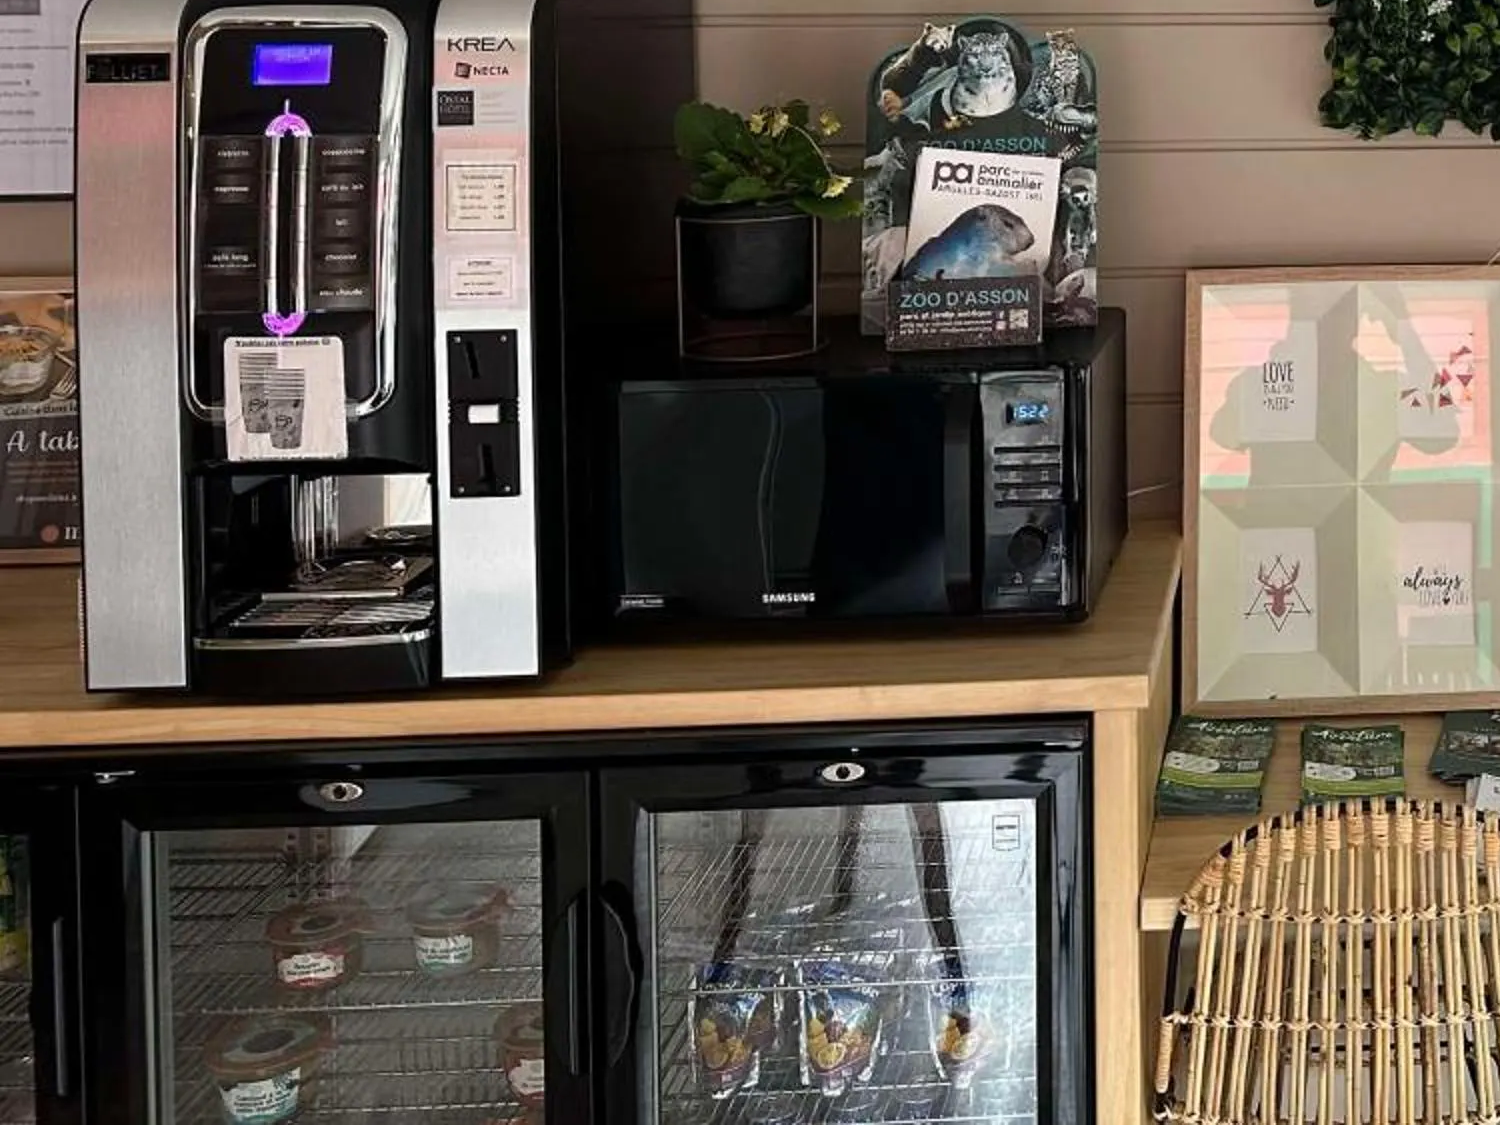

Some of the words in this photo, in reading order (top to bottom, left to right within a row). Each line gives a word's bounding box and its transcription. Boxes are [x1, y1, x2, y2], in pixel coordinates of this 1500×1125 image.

[447, 37, 515, 52] KREA
[87, 65, 158, 80] FLLIET
[473, 66, 509, 76] NECTA
[979, 165, 1011, 176] parc
[977, 176, 1044, 190] animalier
[900, 292, 941, 308] ZOO
[946, 288, 1029, 306] D'ASSON
[1263, 361, 1294, 383] LOVE
[6, 430, 31, 454] A
[1403, 566, 1465, 596] always
[762, 592, 816, 604] SAMSUNG
